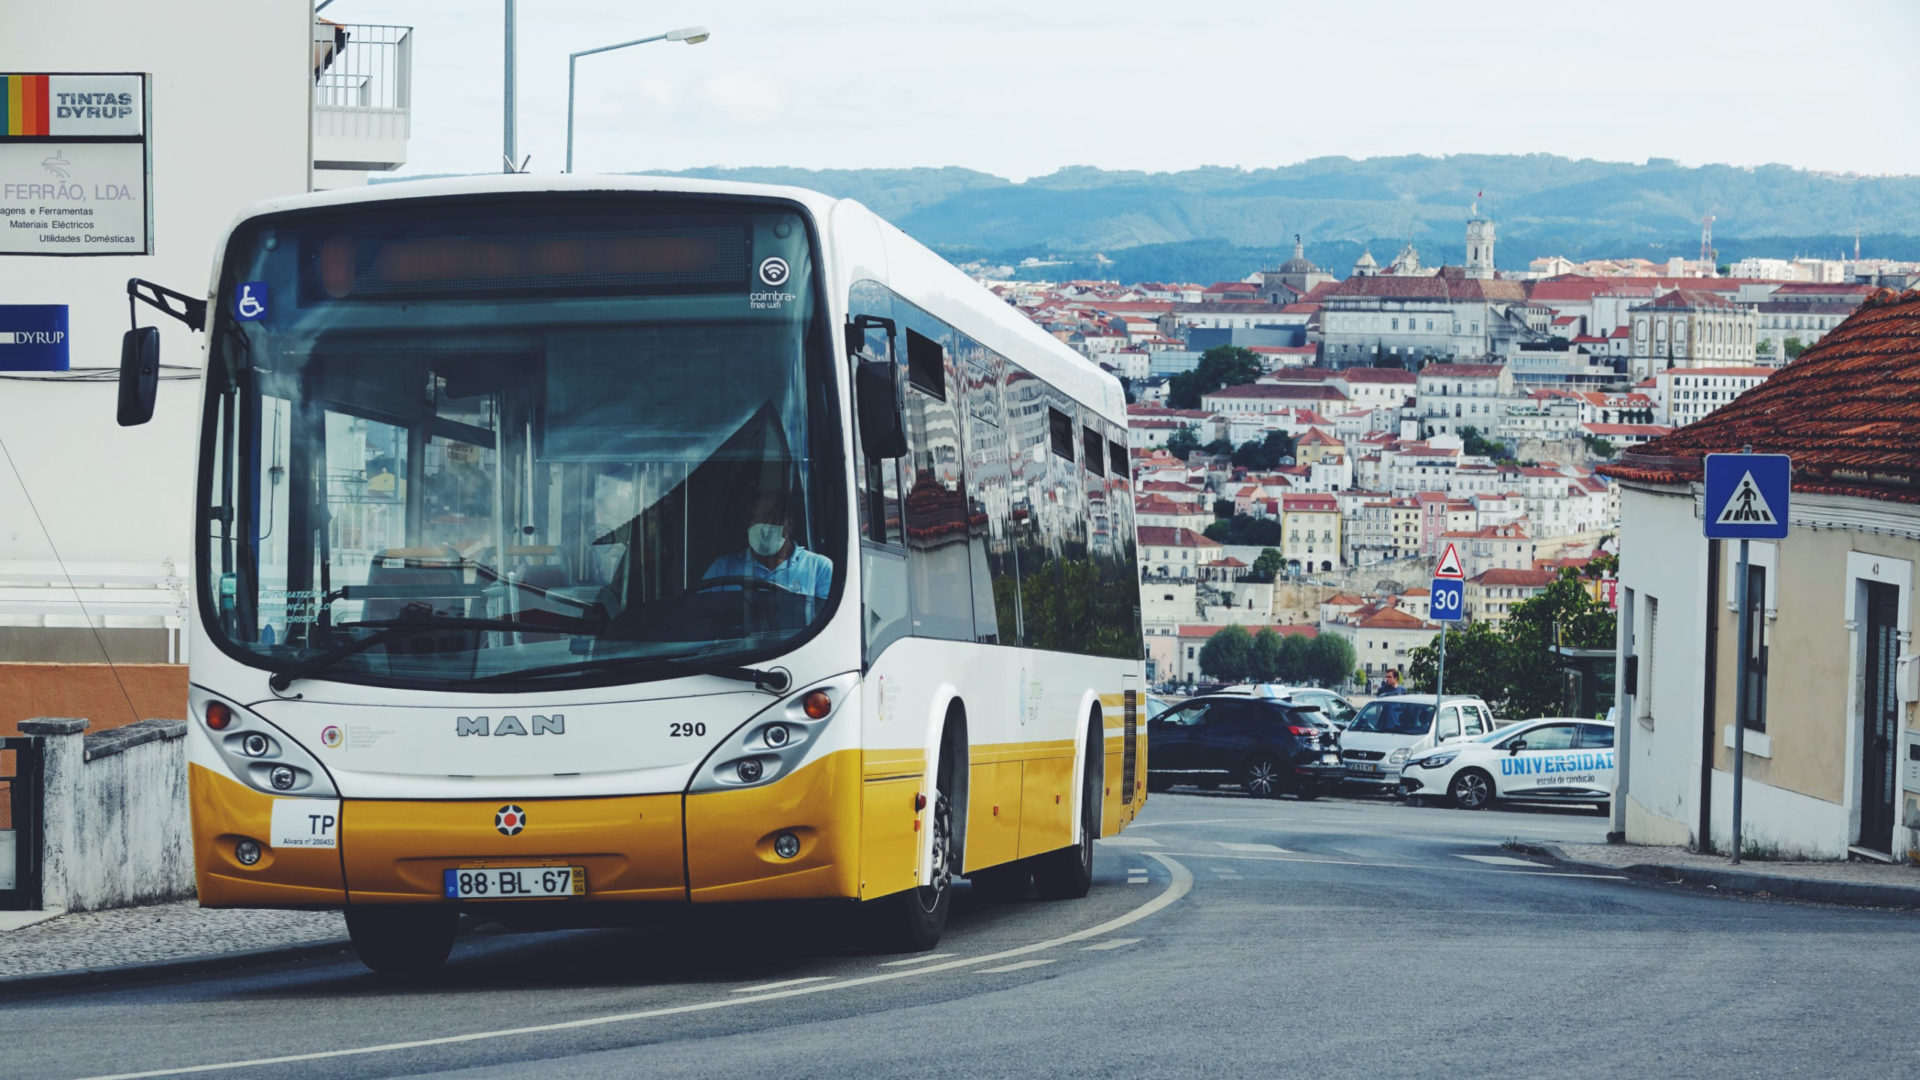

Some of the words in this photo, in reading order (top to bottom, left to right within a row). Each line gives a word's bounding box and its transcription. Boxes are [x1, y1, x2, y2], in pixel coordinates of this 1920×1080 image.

[57, 93, 132, 105] TINTAS
[57, 107, 132, 118] DYRUP
[4, 181, 86, 202] FERRÃO,
[95, 185, 136, 200] LDA.
[39, 207, 94, 215] Ferramentas
[10, 220, 48, 229] Materiais
[52, 220, 94, 229] Eléctricos
[39, 234, 81, 243] Utilidades
[84, 234, 135, 243] Domésticas
[750, 301, 766, 309] free
[767, 301, 781, 309] wifi
[15, 332, 65, 344] DYRUP
[1434, 589, 1459, 610] 30
[457, 714, 565, 737] MAN
[670, 722, 706, 737] 290
[1536, 776, 1556, 786] escola
[1557, 776, 1565, 785] de
[308, 814, 335, 835] TP
